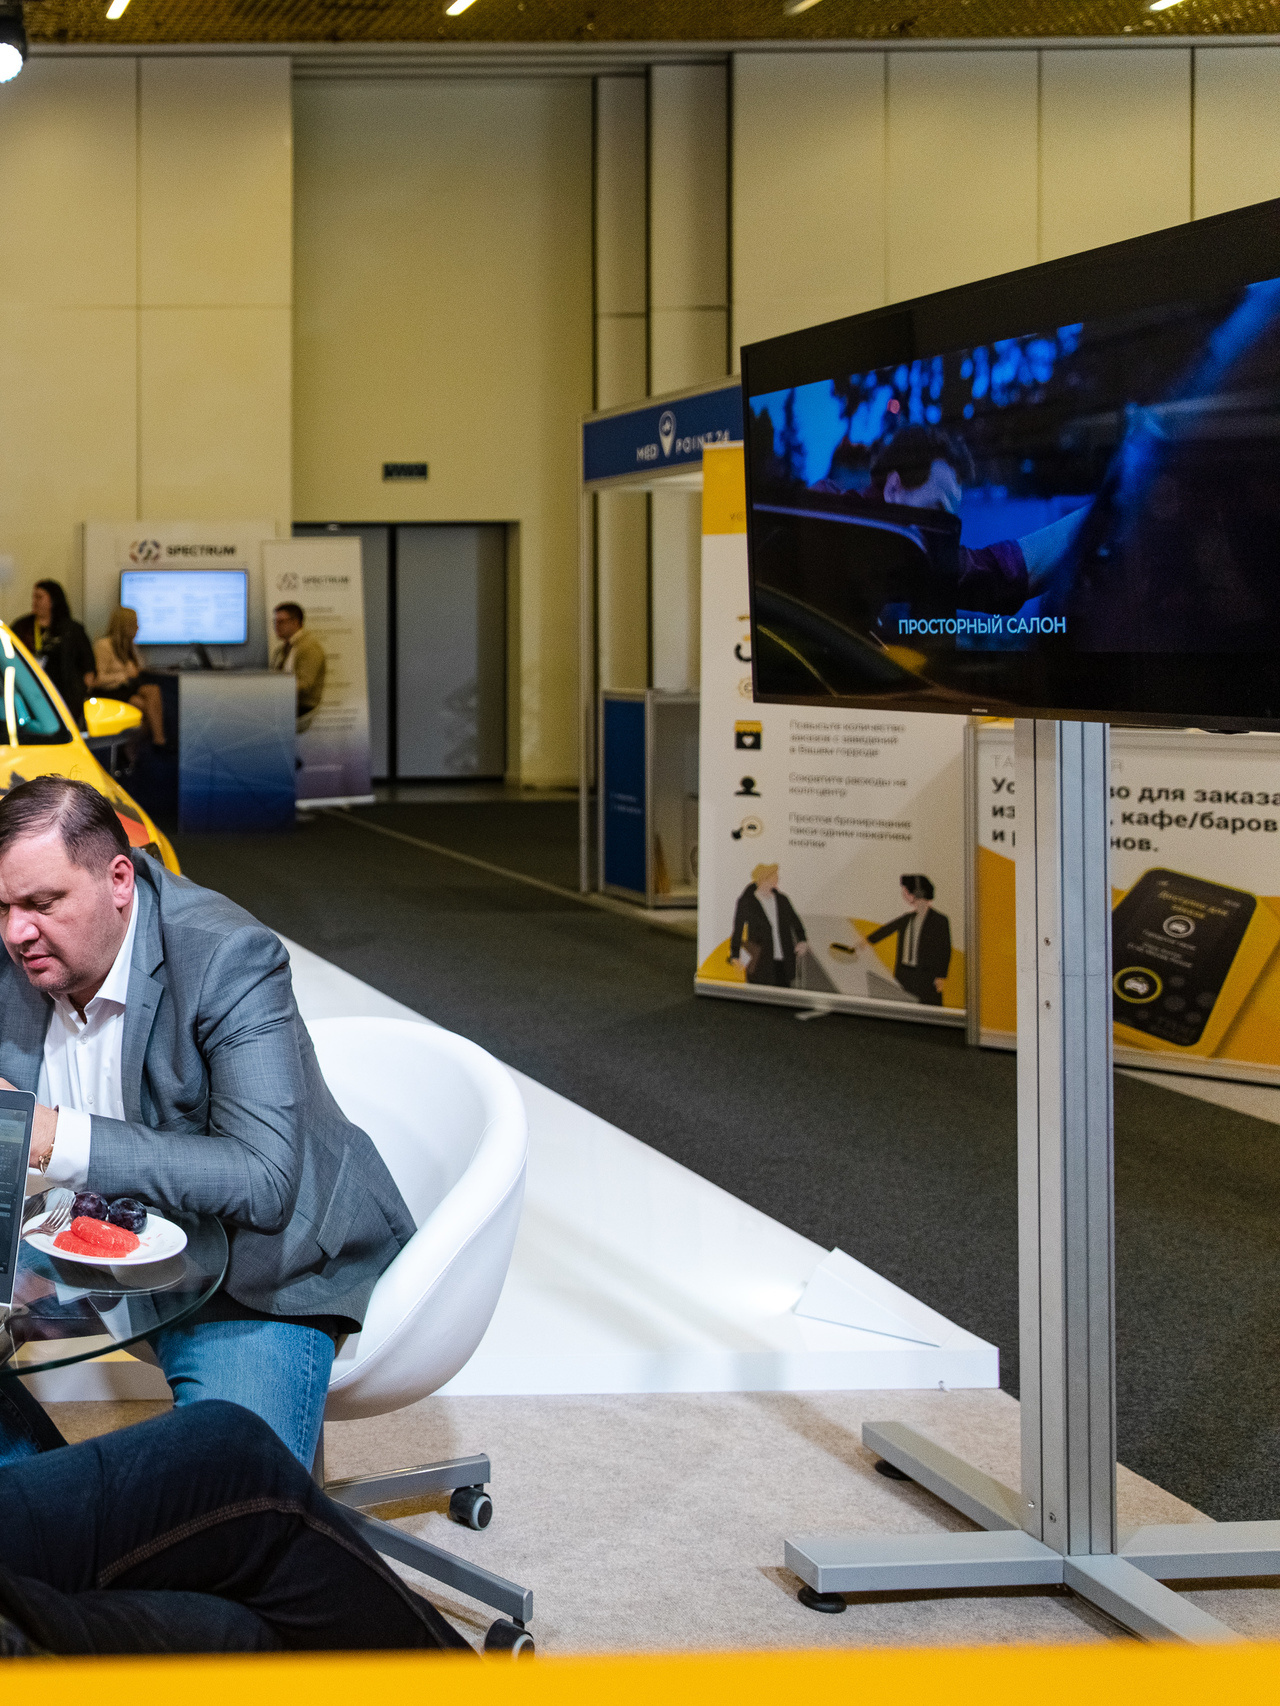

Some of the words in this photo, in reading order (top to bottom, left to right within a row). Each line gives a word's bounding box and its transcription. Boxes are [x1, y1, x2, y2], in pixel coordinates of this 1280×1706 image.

[637, 444, 659, 461] MED
[166, 545, 236, 557] SPECTRUM
[898, 614, 1003, 634] ПРОСТОРНЫЙ
[1006, 617, 1066, 634] САЛОН
[1138, 786, 1185, 804] для
[1121, 809, 1278, 835] кафе/баров
[992, 830, 1004, 842] и
